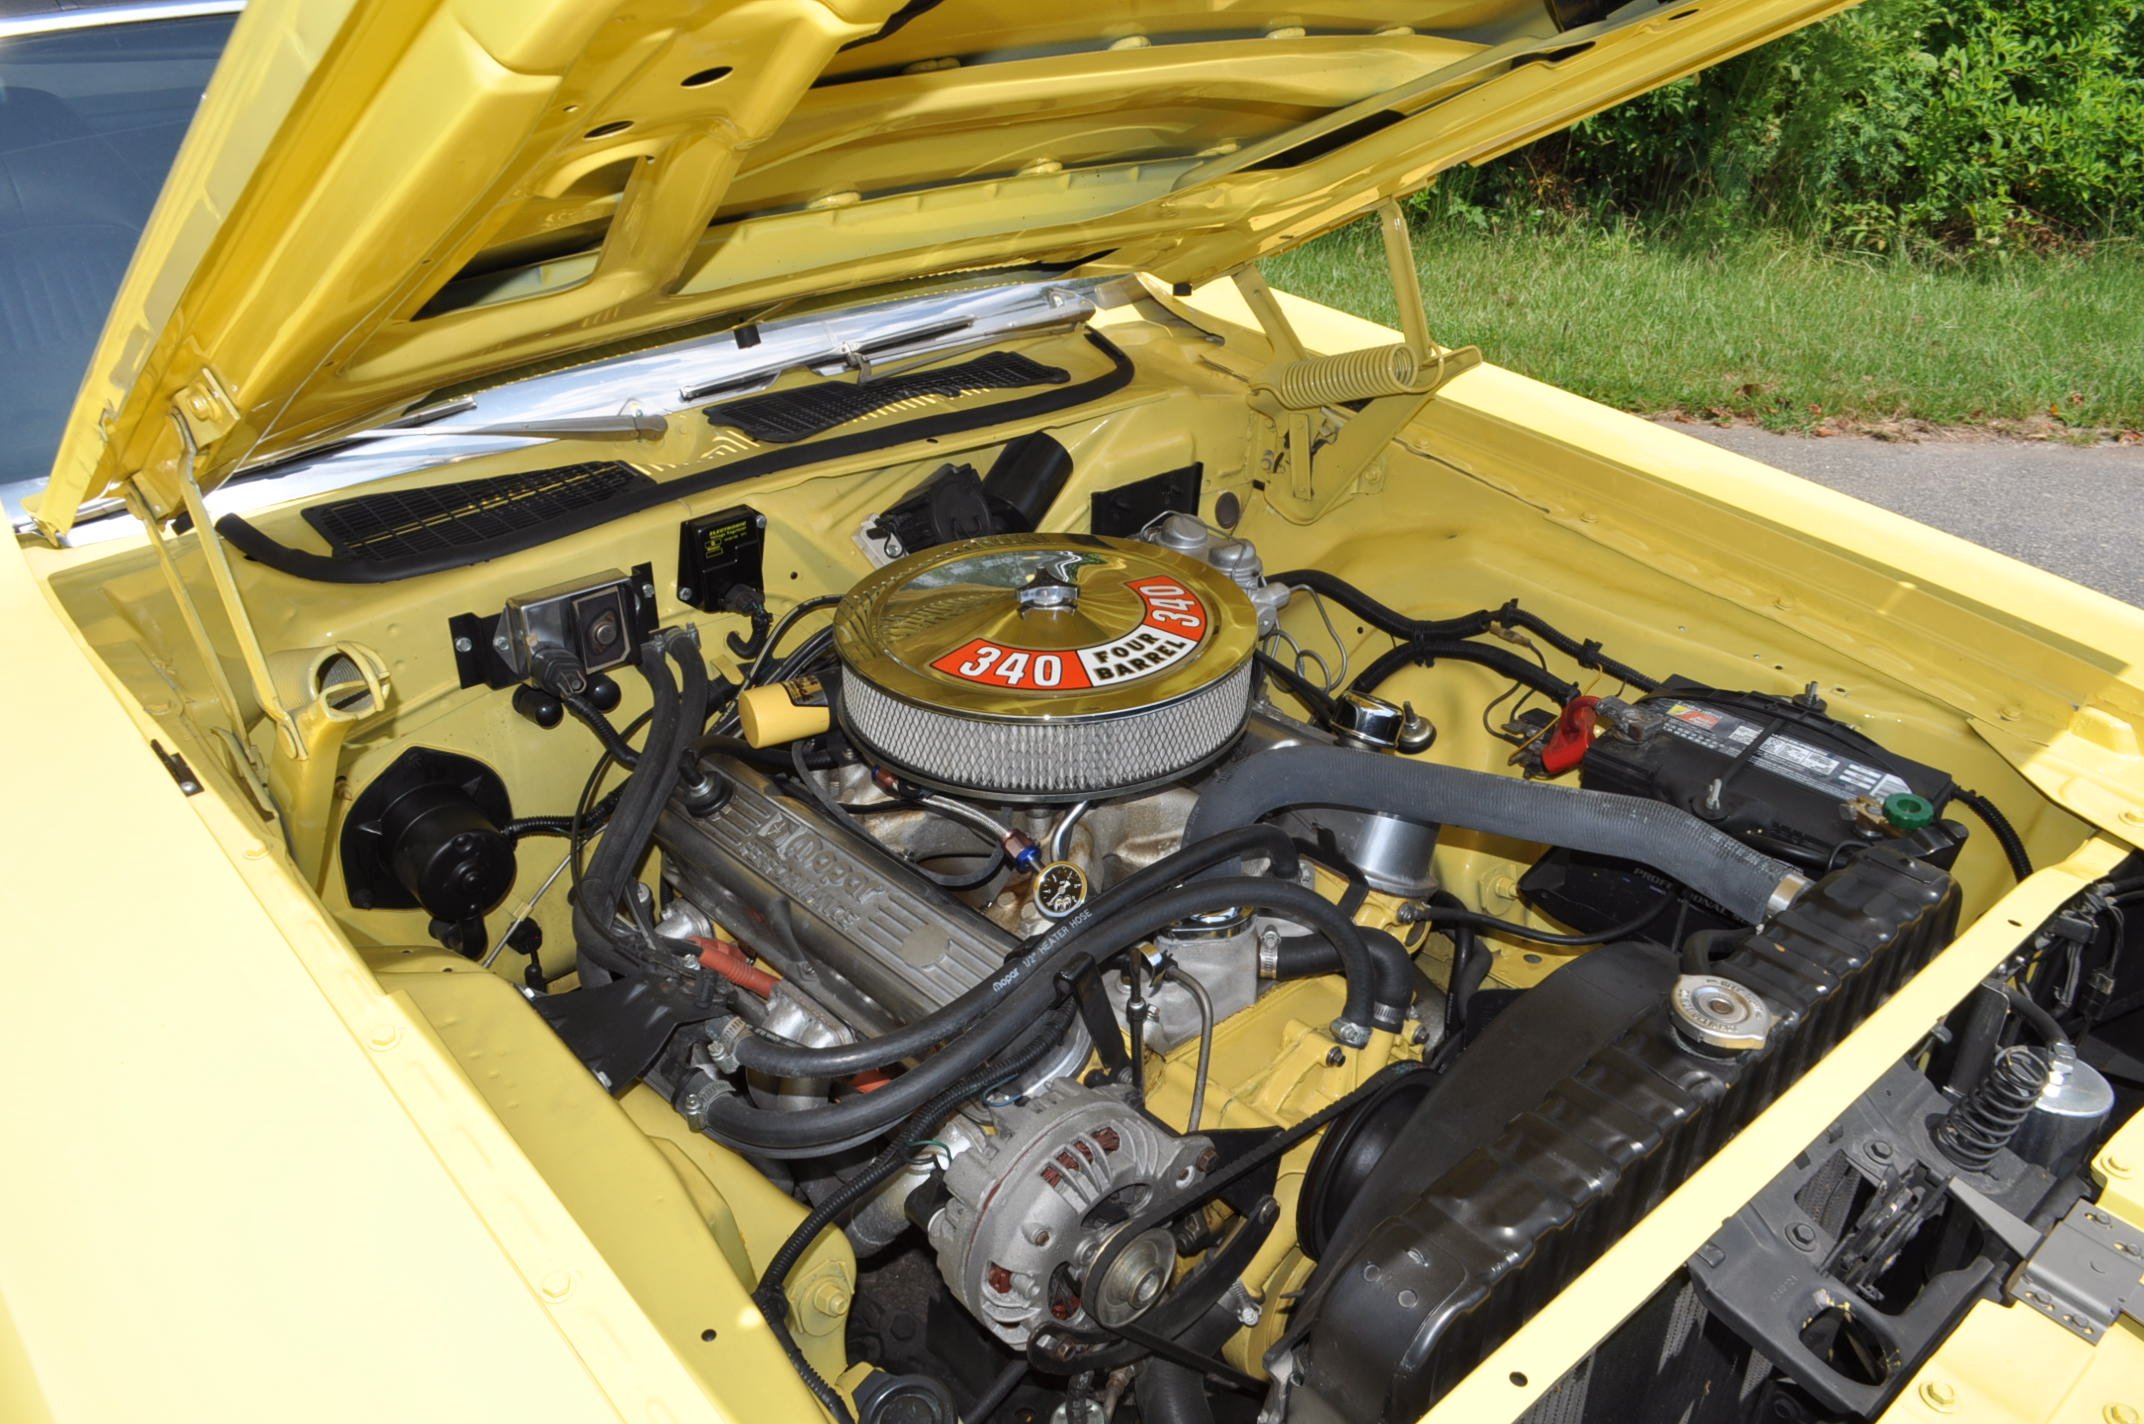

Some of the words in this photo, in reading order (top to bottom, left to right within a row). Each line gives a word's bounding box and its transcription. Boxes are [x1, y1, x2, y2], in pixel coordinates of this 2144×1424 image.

[1138, 584, 1200, 629] 340
[959, 647, 1062, 686] 340
[1094, 640, 1188, 683] BARREL
[1097, 632, 1159, 665] FOUR
[1039, 926, 1070, 954] HEATER
[1069, 908, 1093, 928] HOSE
